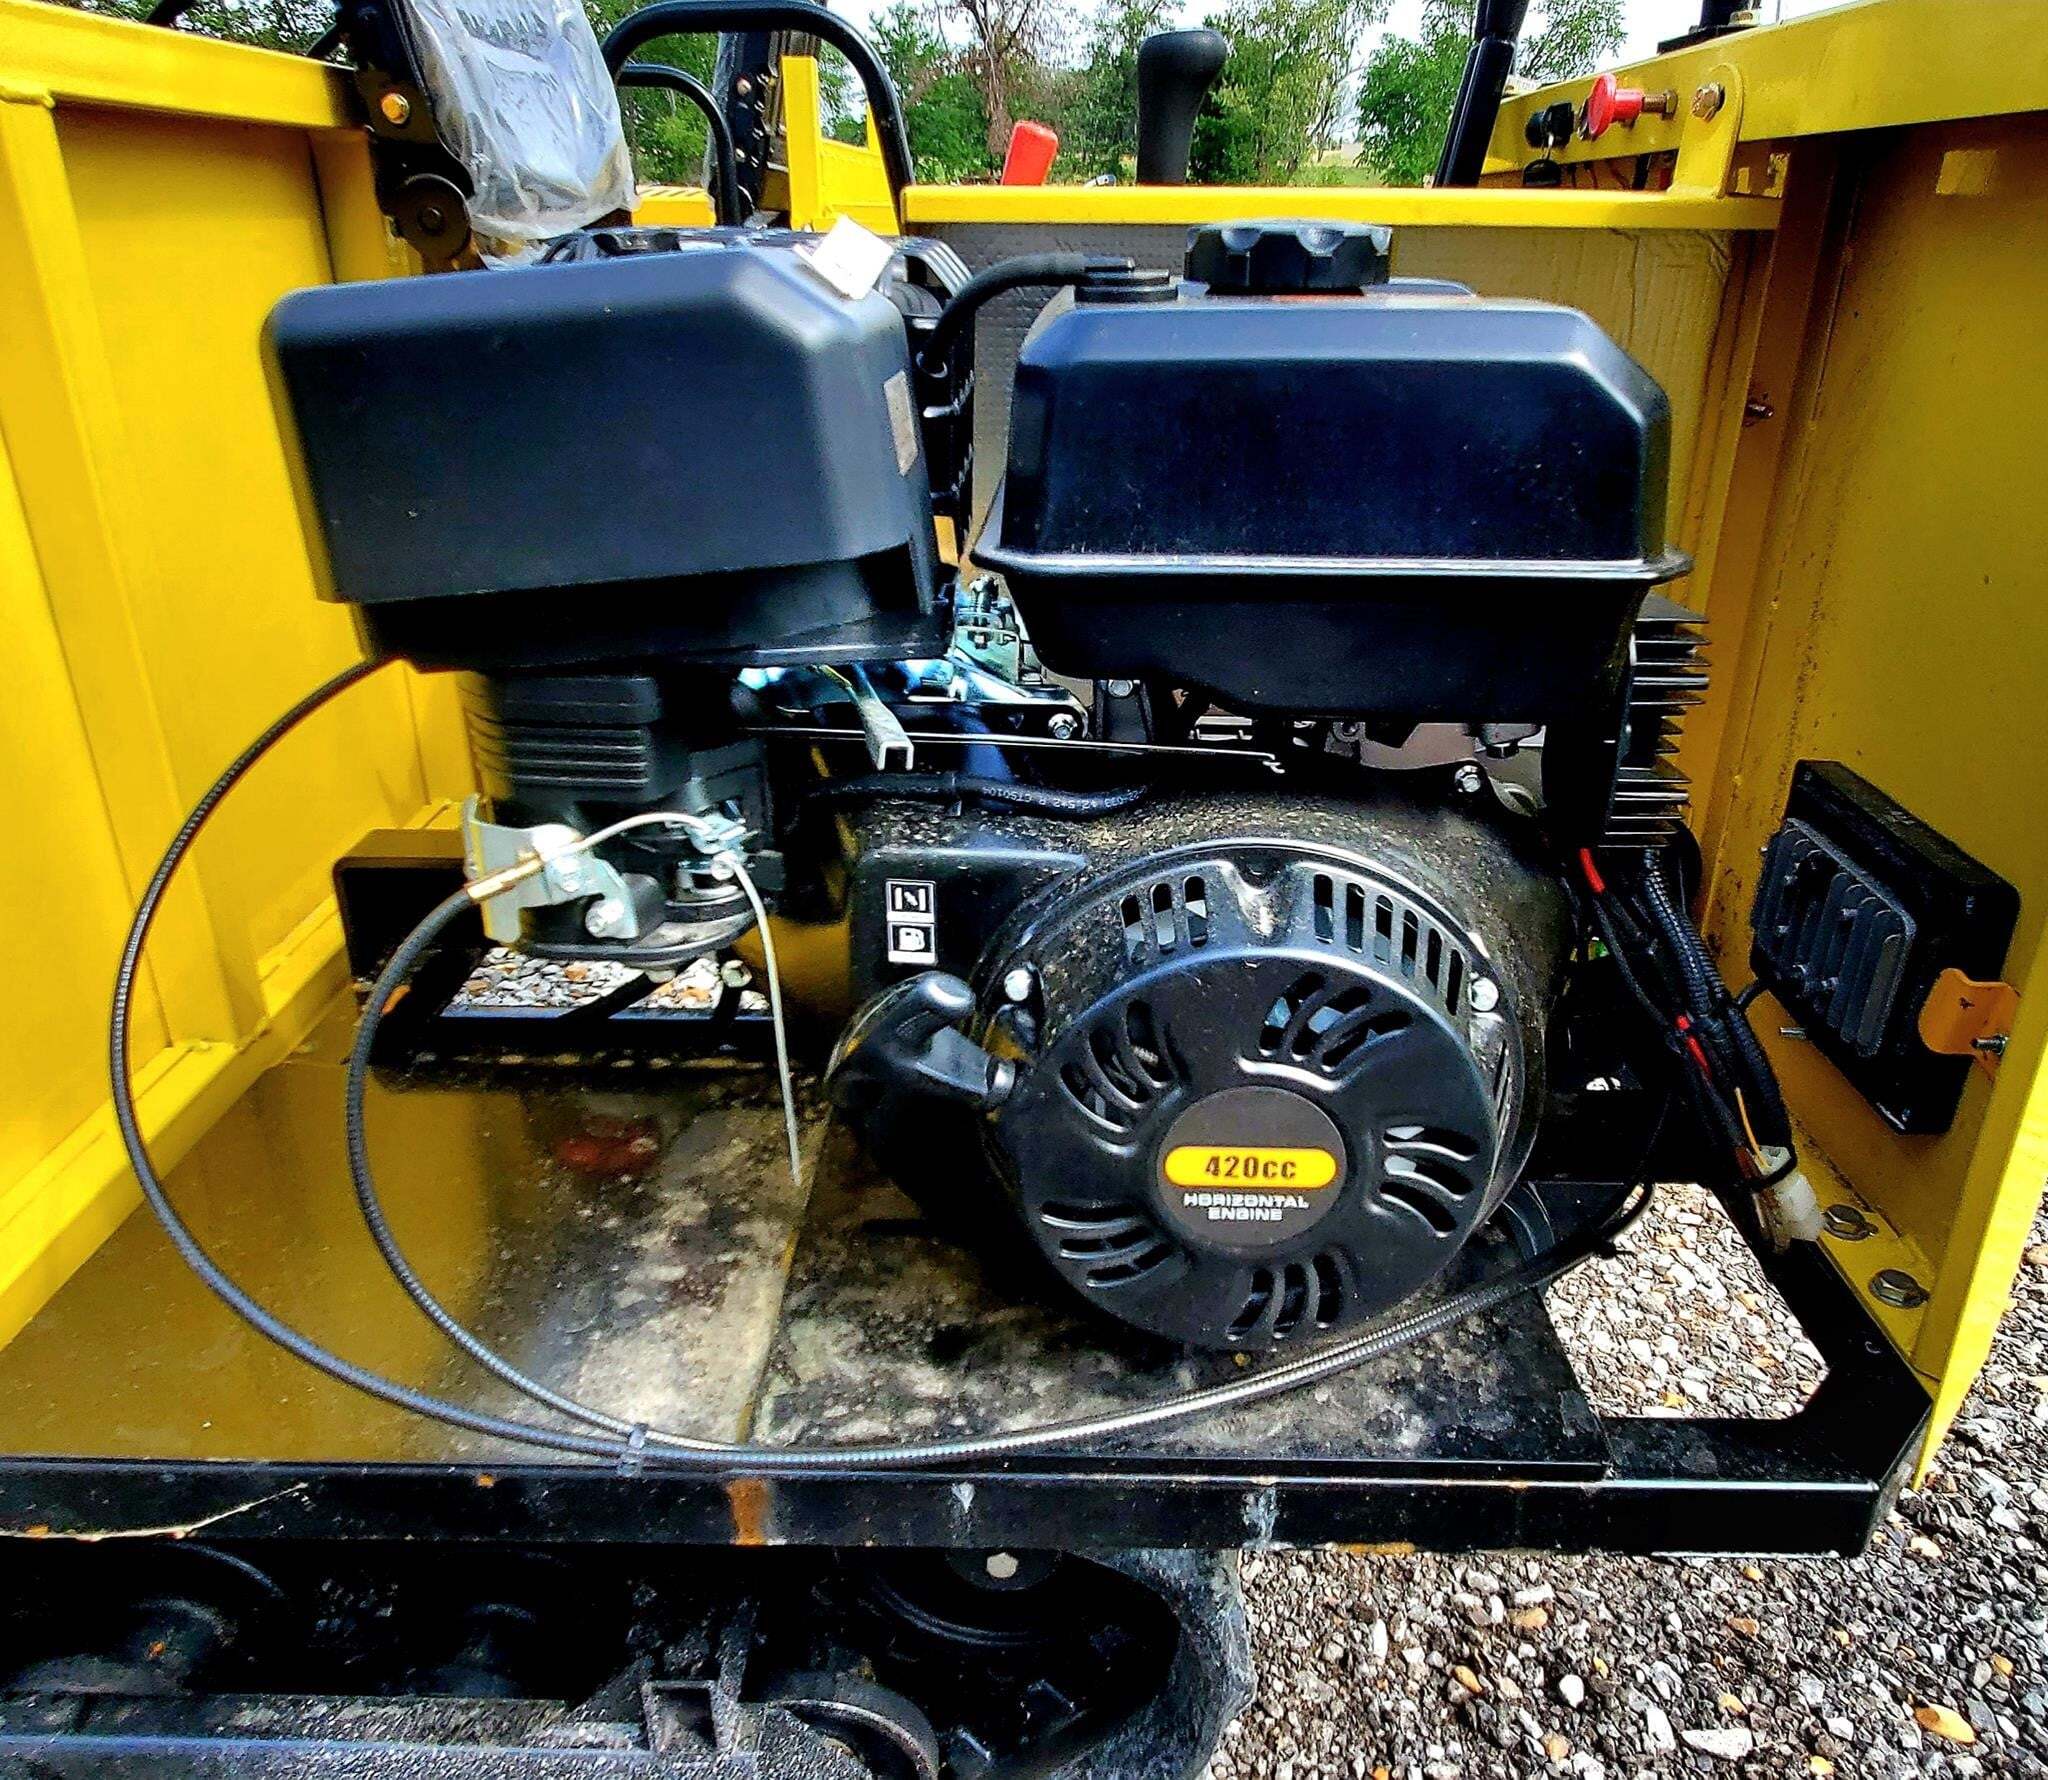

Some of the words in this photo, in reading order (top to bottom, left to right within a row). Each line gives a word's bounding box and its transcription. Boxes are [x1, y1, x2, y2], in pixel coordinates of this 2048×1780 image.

[1205, 1156, 1297, 1179] 420cc
[1183, 1192, 1310, 1209] HORIZONTAL
[1207, 1207, 1283, 1221] ENGINE
